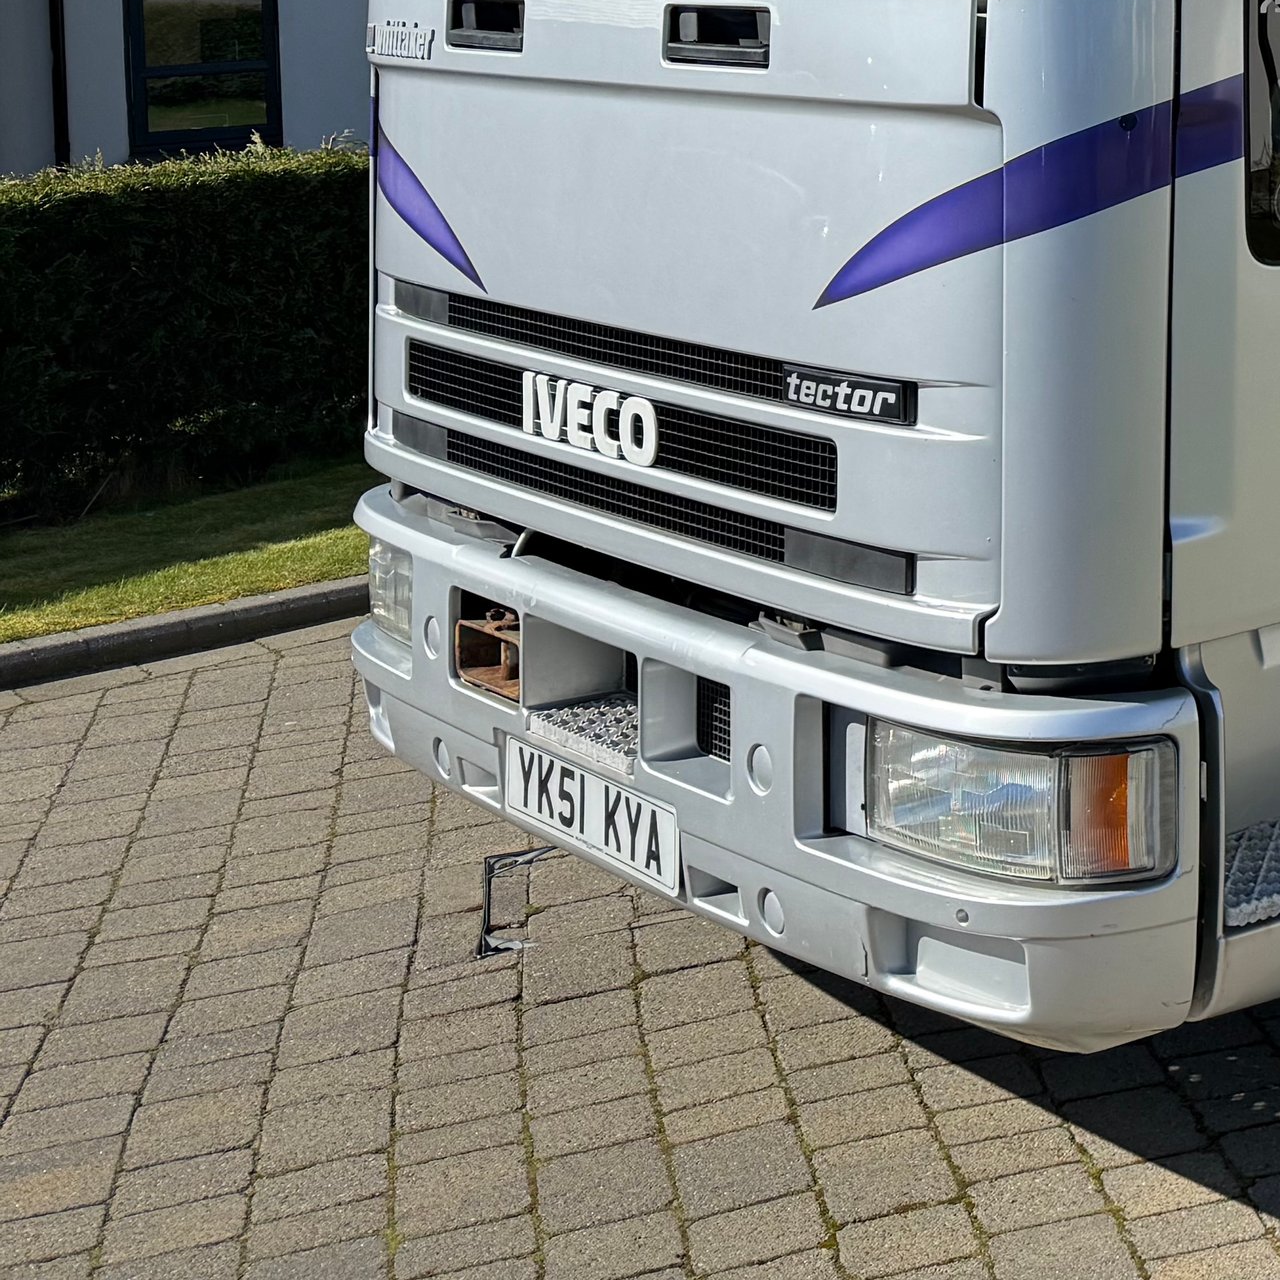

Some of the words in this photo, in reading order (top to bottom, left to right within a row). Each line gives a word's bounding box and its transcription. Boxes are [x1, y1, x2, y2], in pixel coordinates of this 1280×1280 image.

[522, 370, 660, 467] IVECO
[785, 371, 896, 415] tector
[518, 746, 585, 835] YK51
[604, 784, 662, 876] KYA
